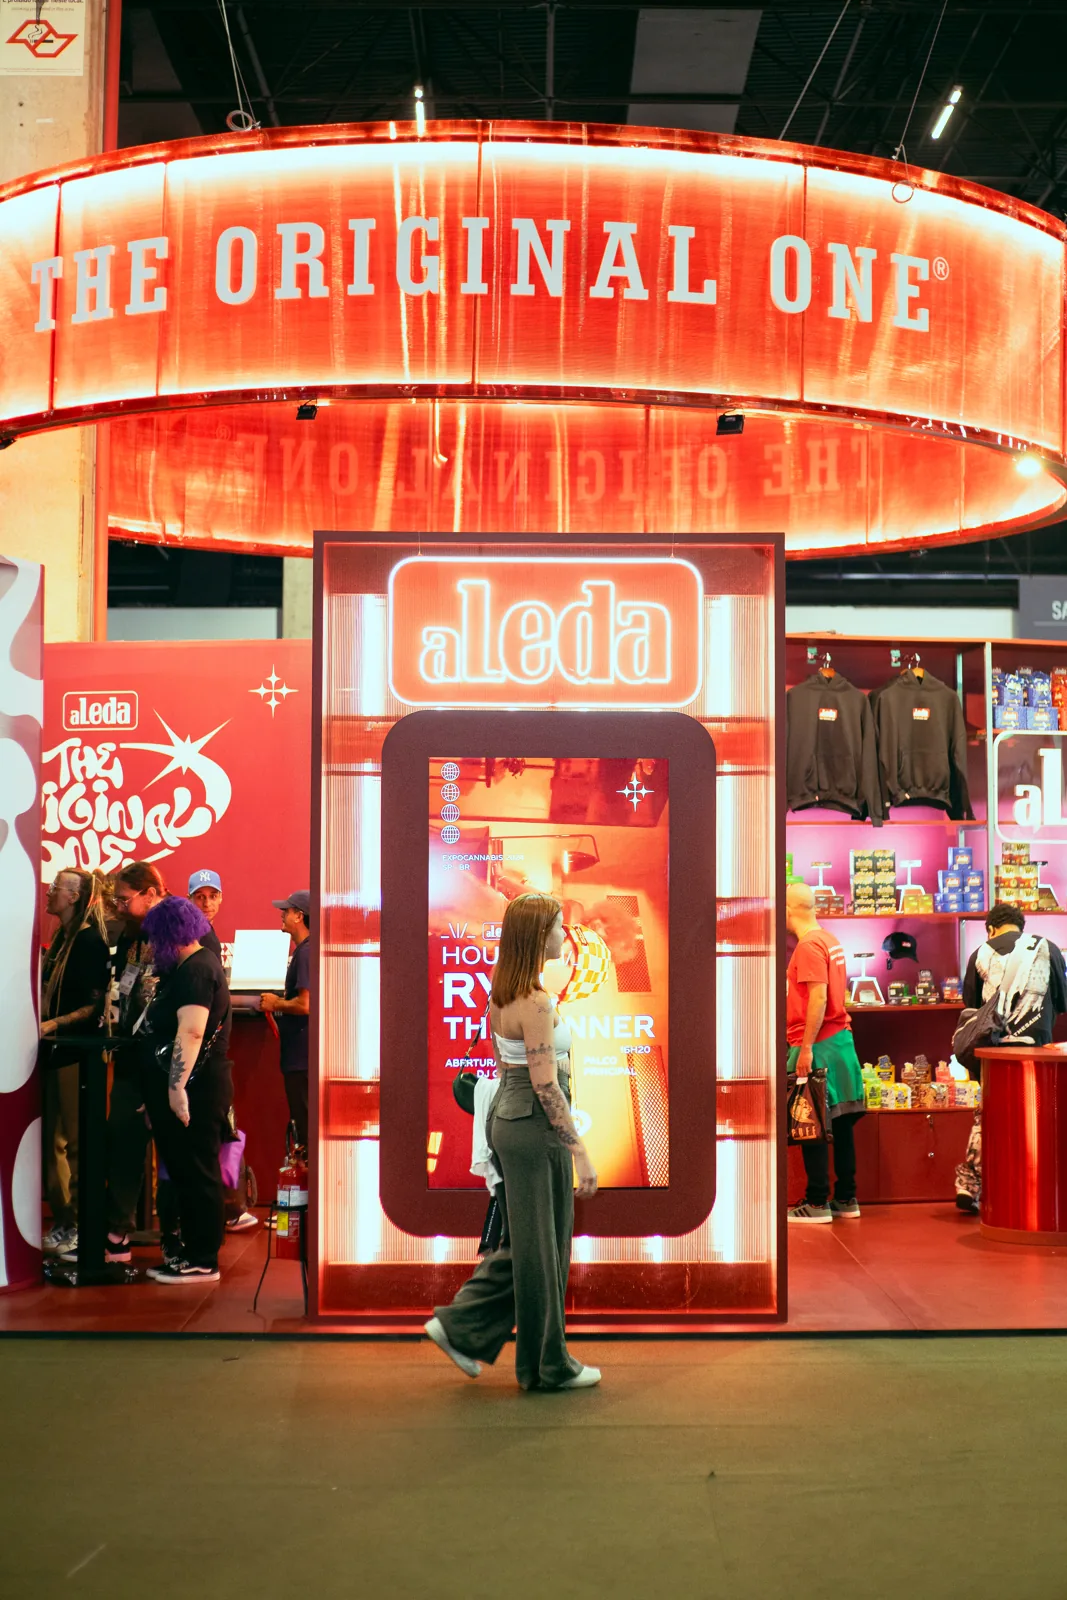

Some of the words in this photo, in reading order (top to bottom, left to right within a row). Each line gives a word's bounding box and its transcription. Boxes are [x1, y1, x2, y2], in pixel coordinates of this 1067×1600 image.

[31, 236, 168, 332] THE
[215, 216, 717, 305] ORIGINAL
[42, 738, 124, 788] THE
